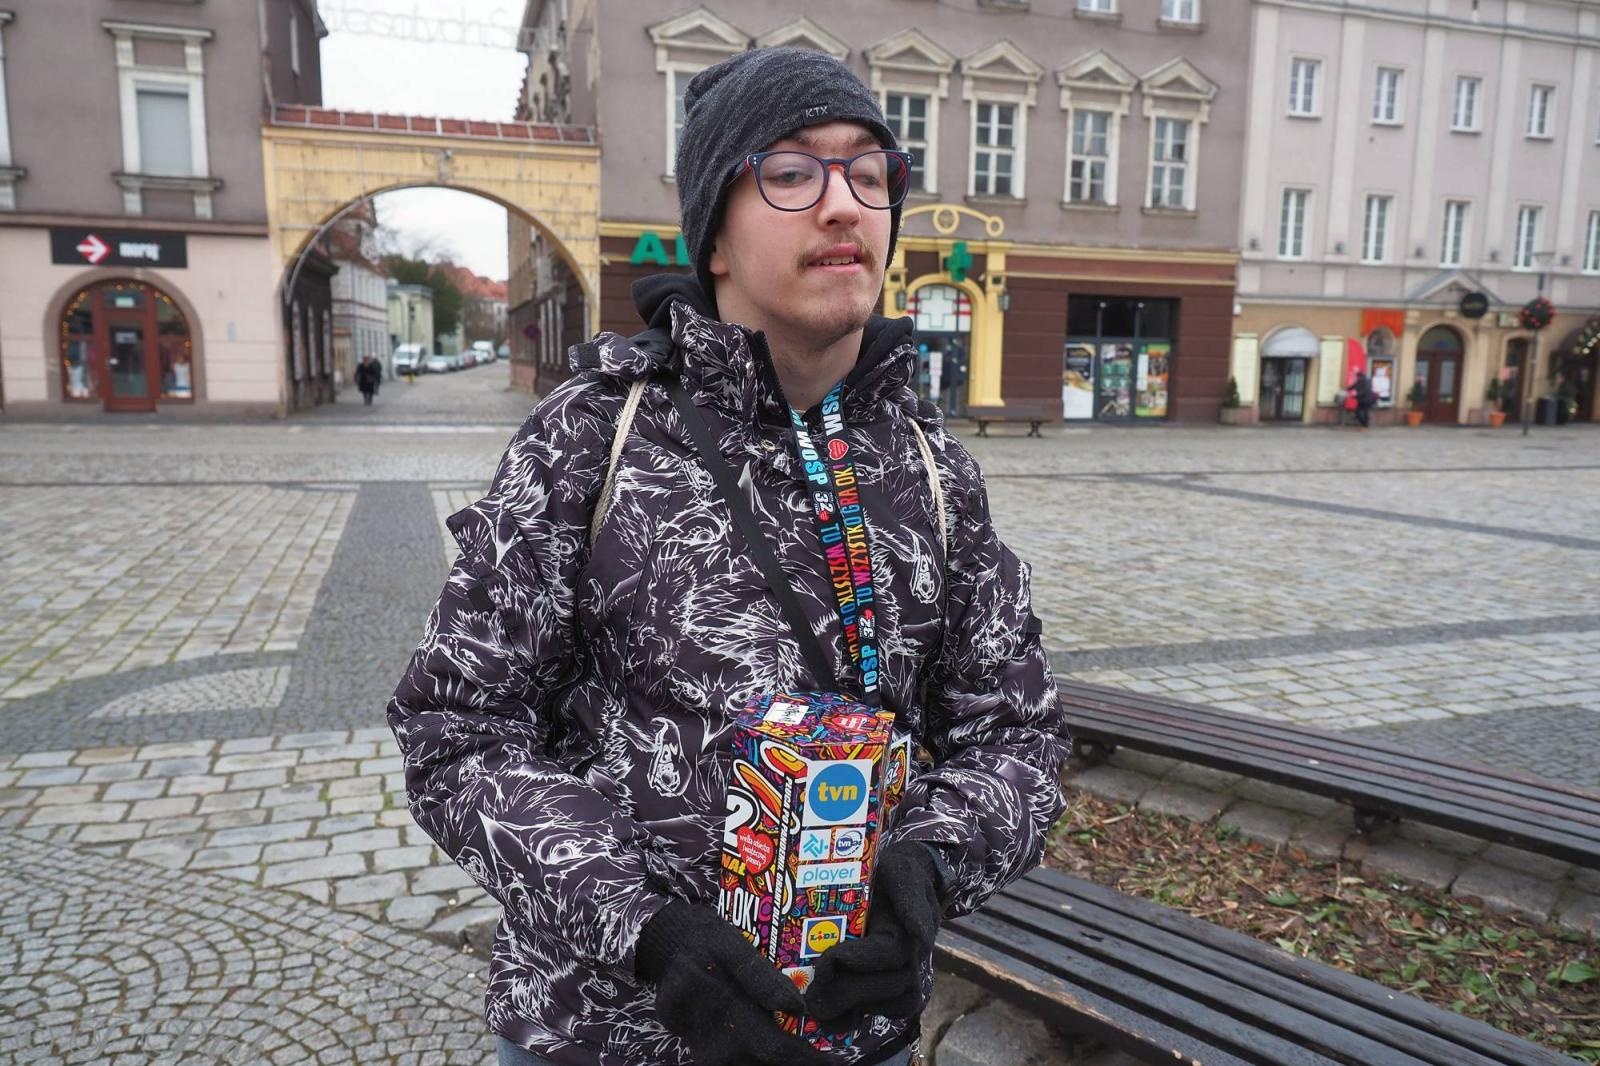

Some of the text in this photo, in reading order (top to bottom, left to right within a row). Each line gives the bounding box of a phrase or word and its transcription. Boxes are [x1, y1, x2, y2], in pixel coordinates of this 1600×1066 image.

[805, 105, 828, 118] KTX
[796, 430, 829, 485] WOŚP
[832, 462, 855, 487] OK!
[815, 492, 834, 513] 32
[838, 486, 861, 514] GRA
[820, 523, 842, 543] TU
[843, 515, 871, 586] WSZYSTKO
[825, 543, 857, 614] WSZYSTKO
[856, 586, 873, 607] TU
[861, 616, 875, 638] 32
[818, 782, 858, 801] tvn
[781, 808, 790, 825] PO
[803, 867, 855, 884] player
[773, 871, 784, 910] GRAMY
[732, 887, 760, 935] OK!
[771, 906, 780, 927] DLA
[768, 925, 778, 957] DZIECI
